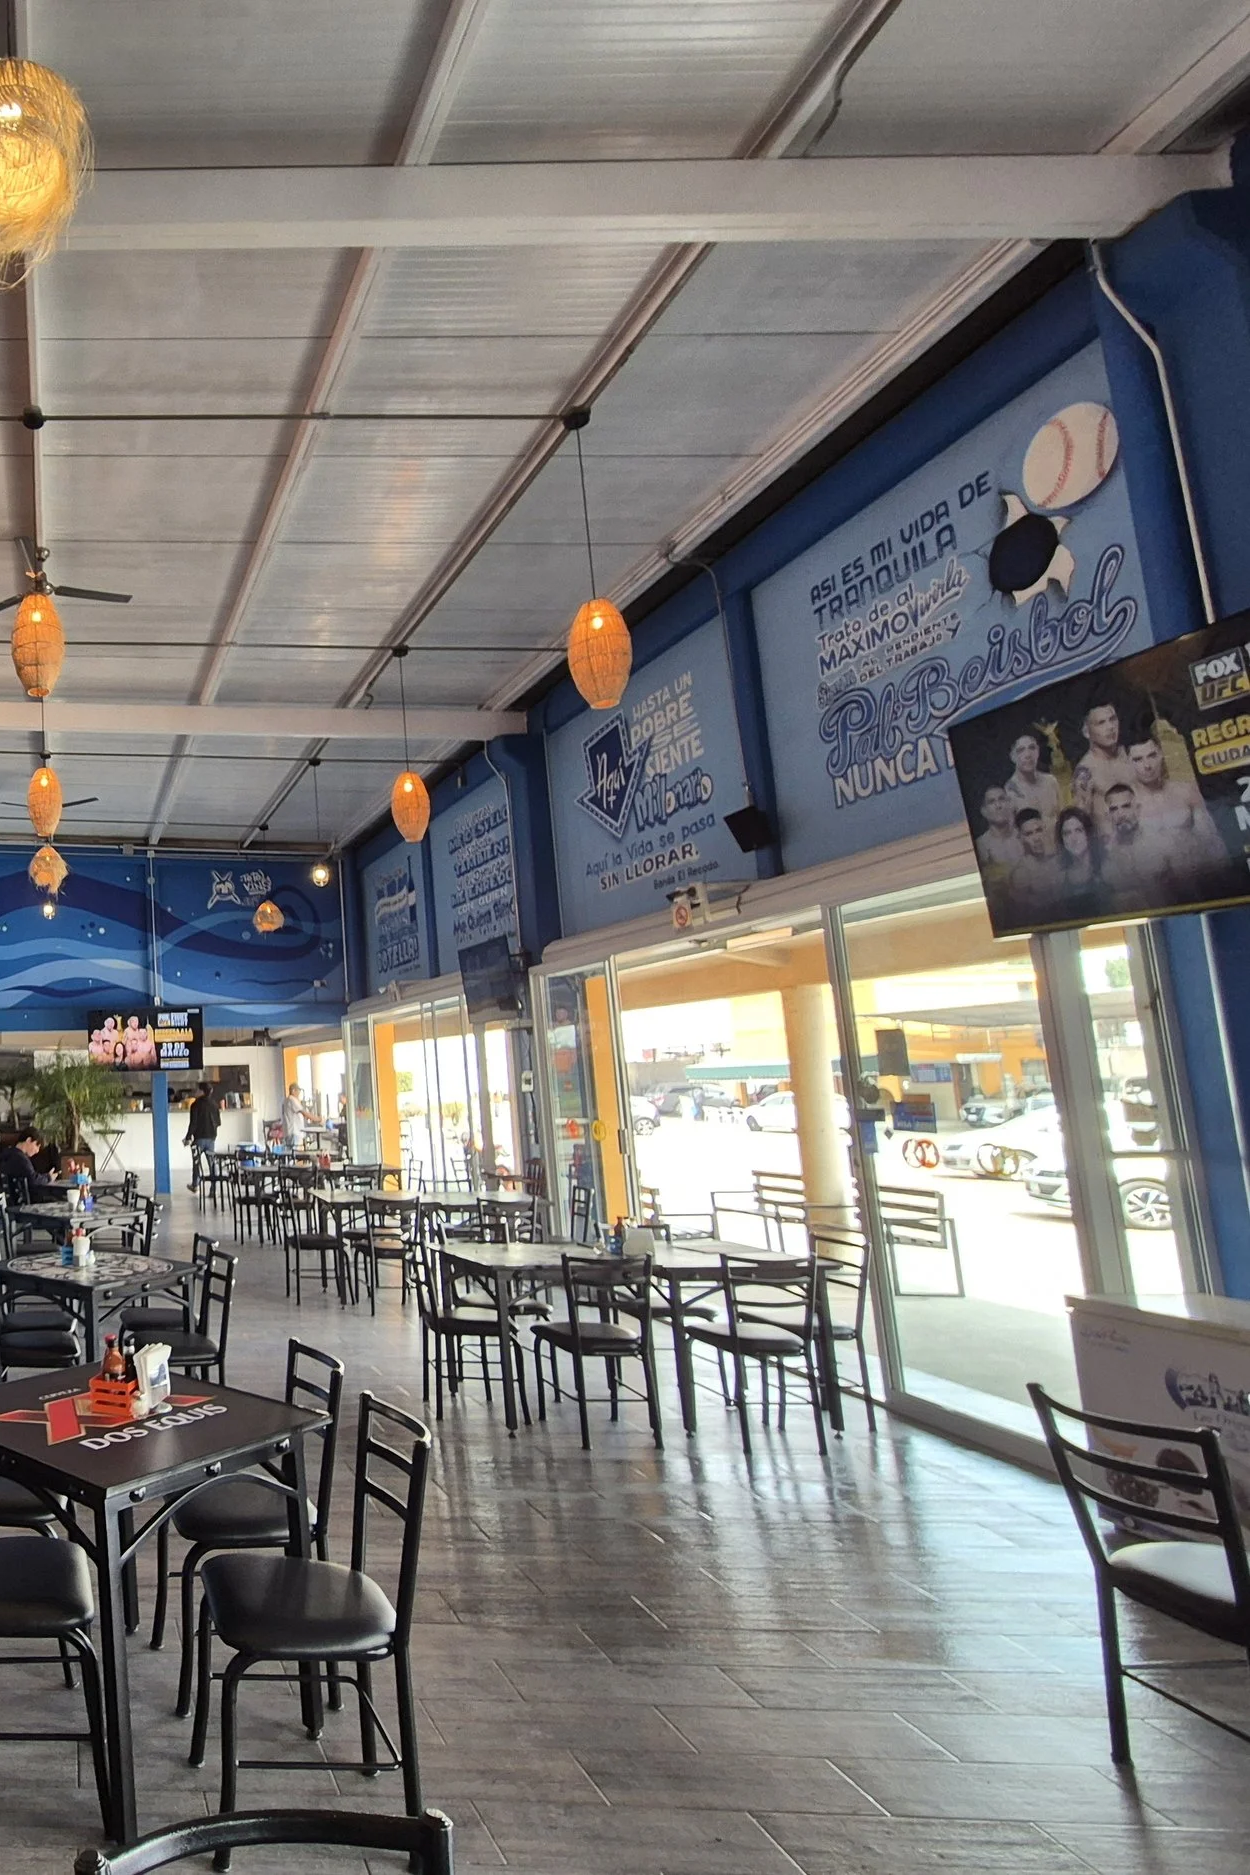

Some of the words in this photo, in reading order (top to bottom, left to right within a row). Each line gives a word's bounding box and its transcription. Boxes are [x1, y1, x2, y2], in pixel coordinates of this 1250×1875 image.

[810, 574, 837, 606] ASI
[841, 555, 865, 585] ES
[870, 536, 893, 567] MI
[899, 500, 950, 544] VIDA
[958, 471, 992, 510] DE
[813, 523, 958, 632] TRANQUILA
[817, 618, 862, 651] Trato
[868, 601, 889, 624] de
[897, 583, 914, 606] al
[818, 610, 909, 677] MAXIMO
[899, 544, 1138, 736] Beisbol
[859, 666, 883, 684] DEL
[886, 633, 943, 668] TRABAJO
[946, 620, 962, 640] Y
[1194, 652, 1242, 685] FOX
[632, 686, 671, 721] HASTA
[674, 670, 693, 694] UN
[1201, 672, 1250, 701] UFC
[630, 691, 694, 750] POBRE
[650, 712, 700, 750] SE
[644, 729, 705, 785] SIENTE
[833, 736, 942, 809] NUNCA
[600, 873, 620, 892] SIN
[626, 842, 701, 883] LLORAR.
[611, 851, 623, 868] la
[626, 839, 654, 860] Vida
[659, 829, 675, 846] se
[681, 812, 717, 841] pasa
[79, 1425, 150, 1451] DOS
[147, 1403, 230, 1433] EQUIS
